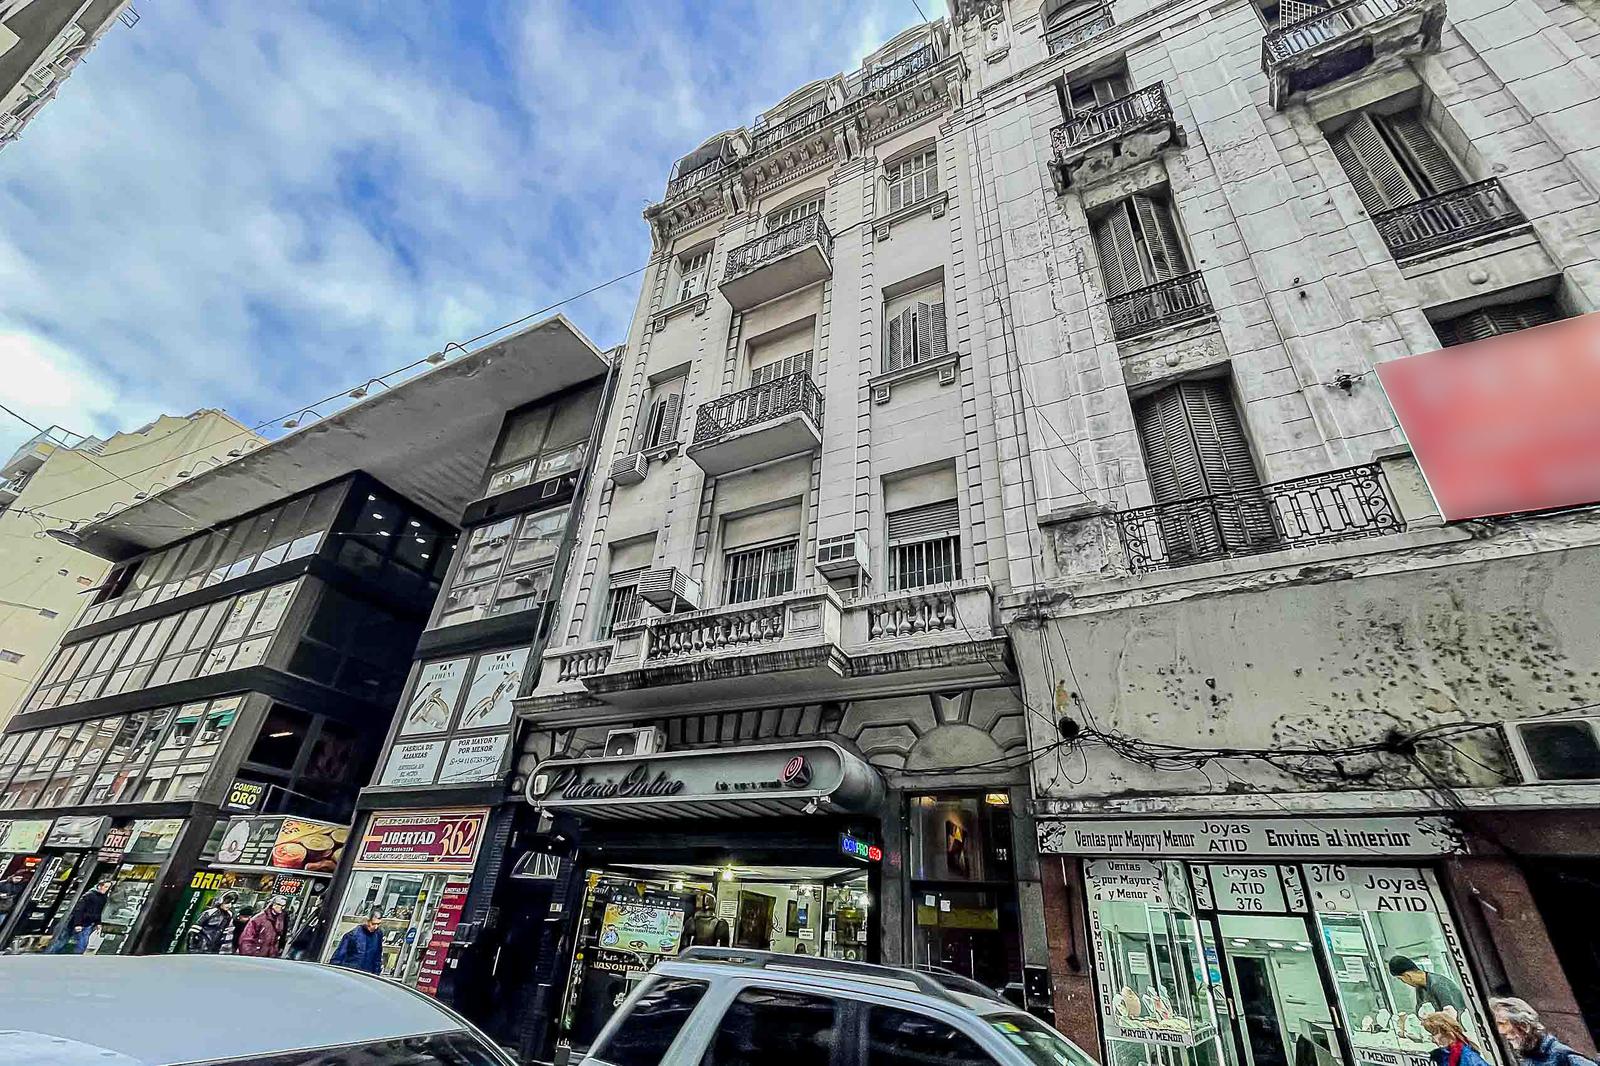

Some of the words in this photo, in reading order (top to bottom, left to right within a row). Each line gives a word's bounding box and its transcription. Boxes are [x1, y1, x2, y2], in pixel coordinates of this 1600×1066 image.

[233, 782, 262, 794] COMPRO
[230, 791, 257, 805] ORO
[1200, 821, 1251, 837] Joyas
[381, 831, 436, 845] LIBERTAD
[434, 815, 478, 862] 362
[1075, 830, 1106, 847] Ventas
[1108, 833, 1123, 851] por
[1163, 830, 1196, 847] Menor
[1265, 829, 1320, 847] Envios
[1326, 828, 1342, 847] al
[1344, 828, 1411, 847] interior
[1208, 839, 1248, 852] ATID
[1108, 861, 1140, 871] Ventas
[1222, 866, 1267, 881] Joyas
[191, 871, 224, 890] ORO
[1101, 876, 1117, 886] por
[1119, 875, 1151, 887] Mayor
[1311, 865, 1346, 883] 376
[1230, 883, 1265, 895] ATID
[1365, 875, 1430, 893] Joyas
[1108, 890, 1114, 900] y
[1116, 889, 1148, 899] Menor
[1236, 898, 1262, 911] 376
[1377, 897, 1428, 912] ATID
[1092, 911, 1105, 971] COMPRO
[1102, 984, 1111, 1016] ORO
[1441, 923, 1475, 997] COMPRO
[1121, 1028, 1147, 1039] MAYOR
[1148, 1031, 1155, 1040] Y
[1156, 1033, 1184, 1043] MENOR
[1360, 1050, 1366, 1060] Y
[1367, 1052, 1398, 1065] MENOR
